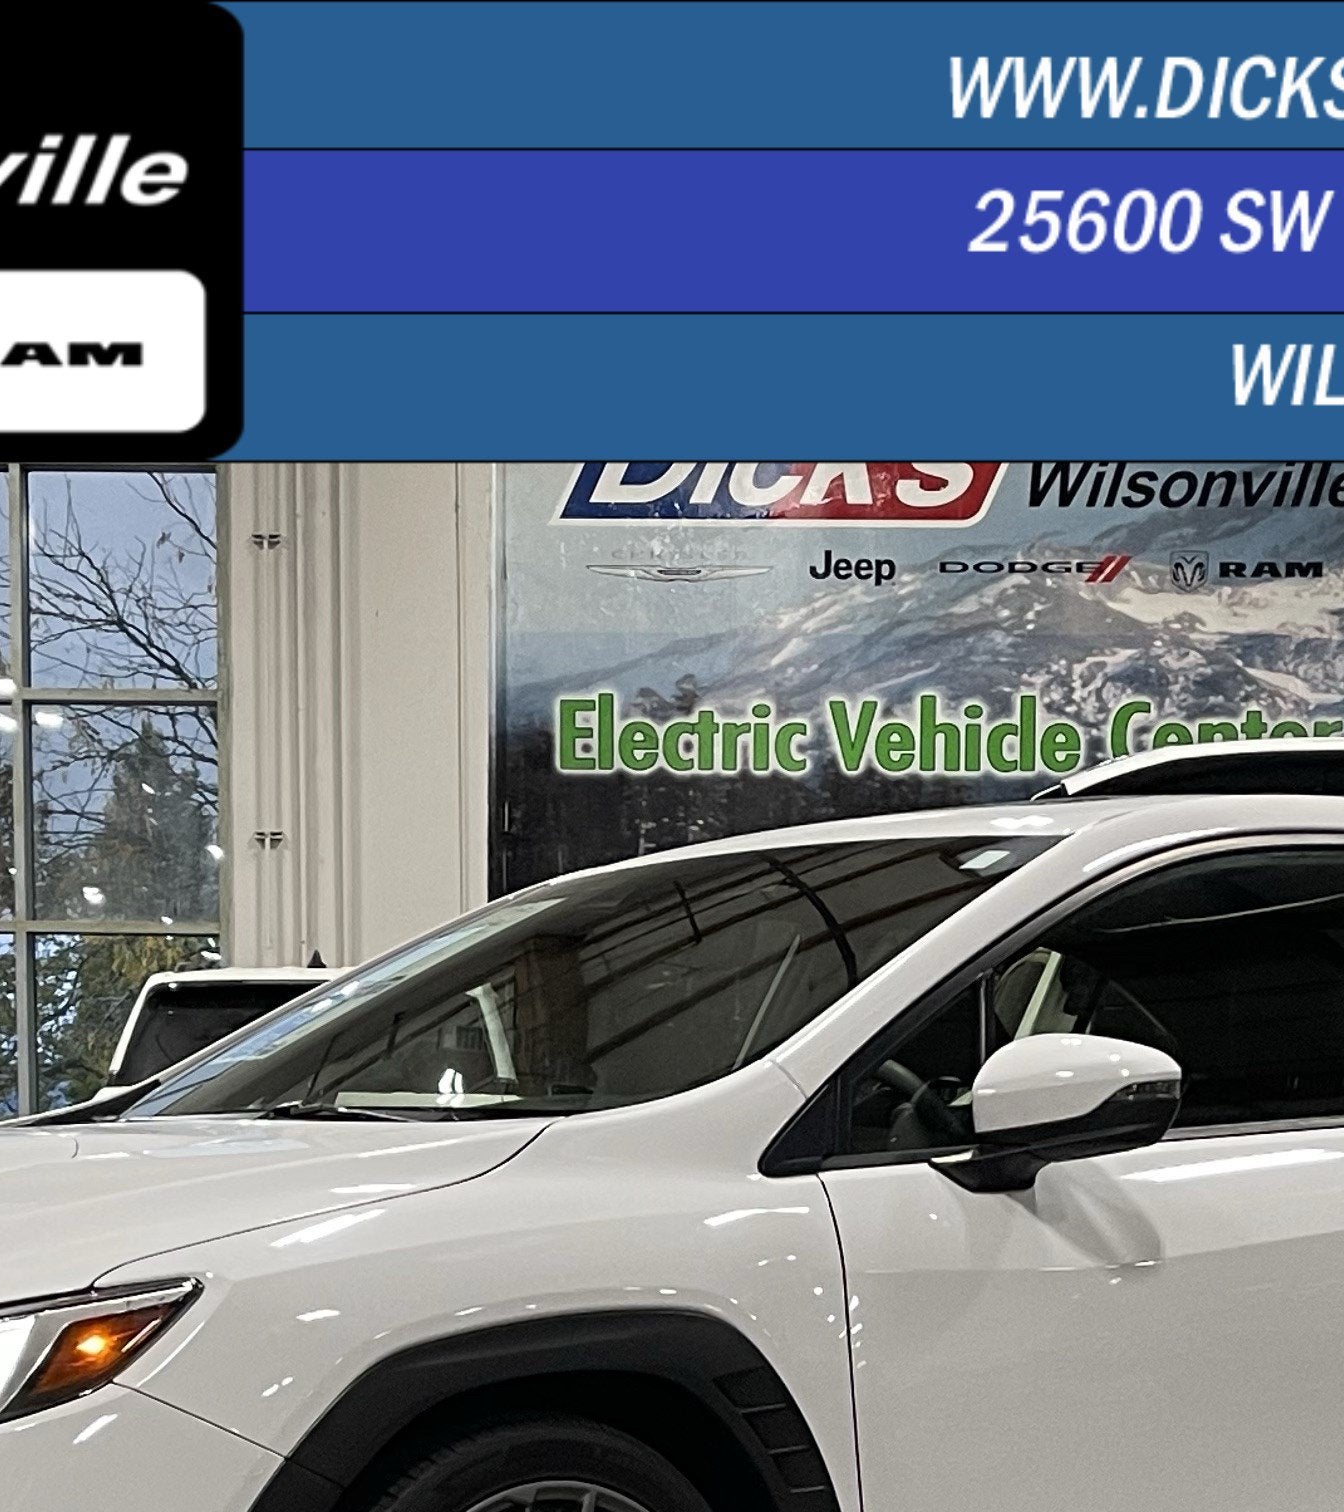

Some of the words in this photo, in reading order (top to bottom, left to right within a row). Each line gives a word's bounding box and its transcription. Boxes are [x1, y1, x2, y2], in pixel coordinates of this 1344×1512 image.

[809, 550, 897, 586] Jeep
[939, 561, 1102, 574] DODGE
[1219, 561, 1323, 578] RAM
[559, 693, 807, 773] Electric
[829, 695, 1082, 773] Vehicle
